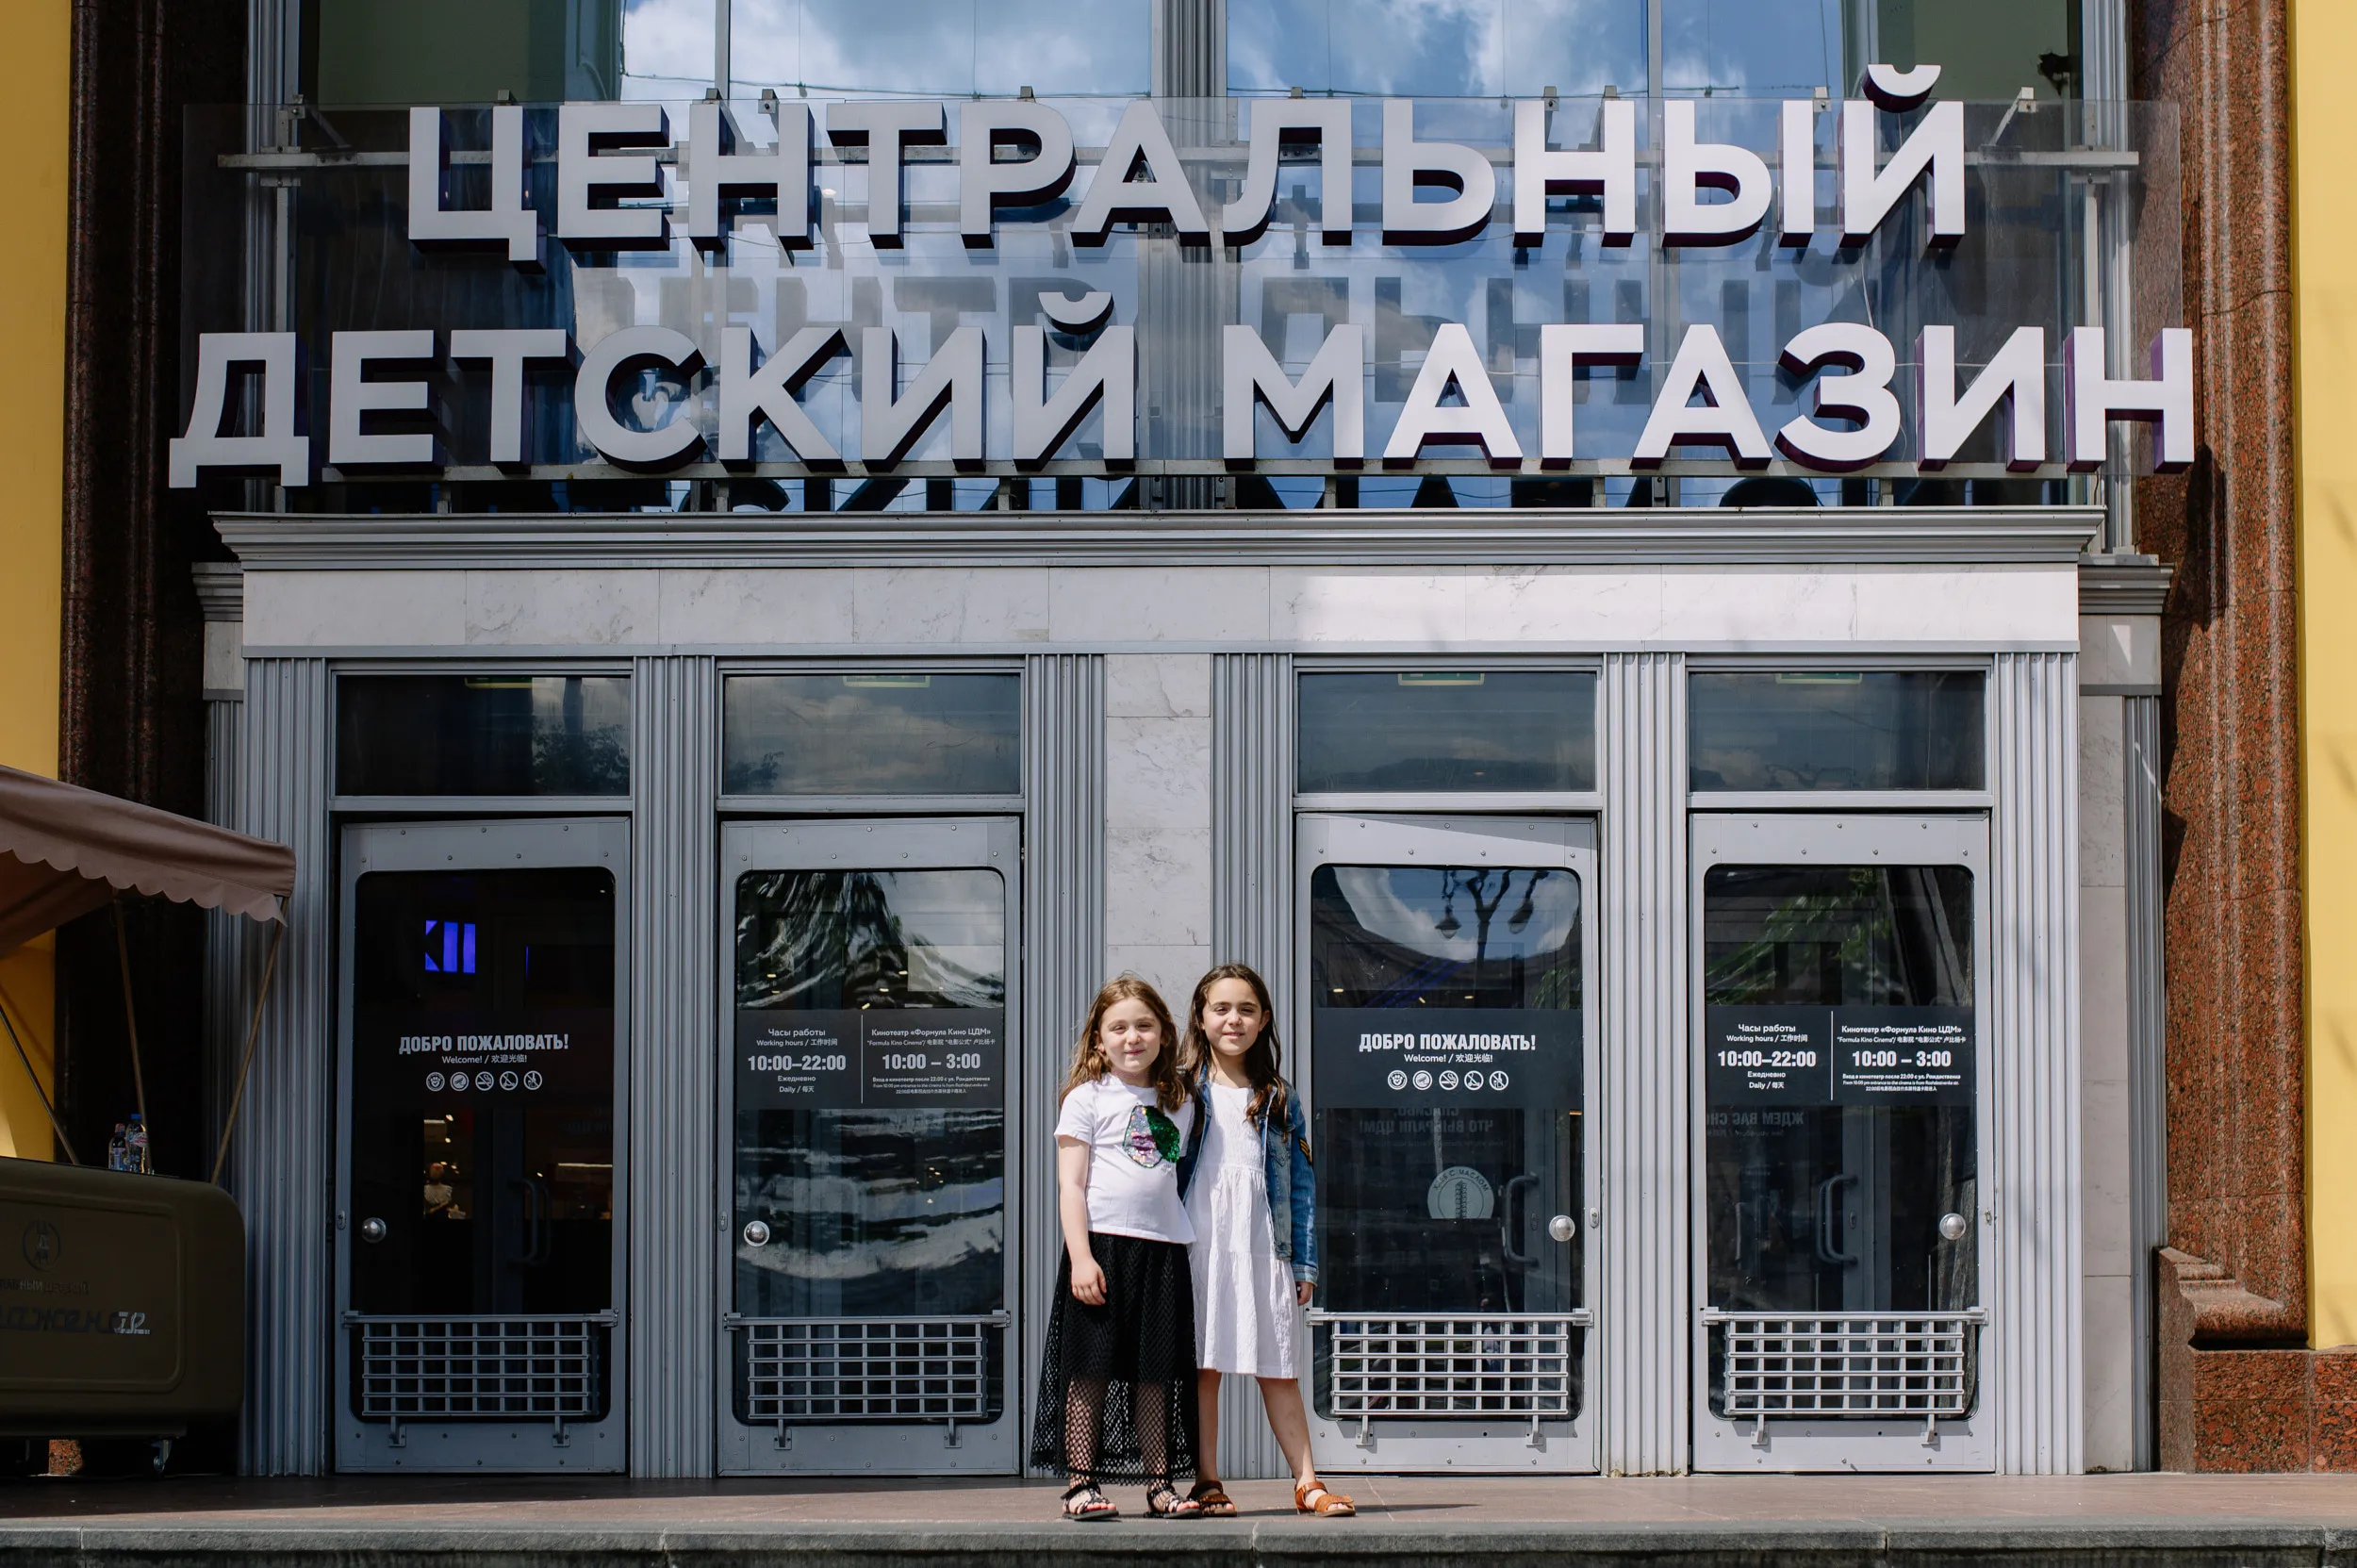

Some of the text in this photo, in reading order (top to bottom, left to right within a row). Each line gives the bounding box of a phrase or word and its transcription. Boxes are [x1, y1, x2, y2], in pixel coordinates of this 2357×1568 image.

[408, 64, 1966, 263] ЦЕНТРАЛЬНЫЙ
[170, 291, 2195, 488] ДЕТСКИЙ МАГАЗИН
[793, 1029, 826, 1037] работы
[871, 1029, 909, 1037] Кинотеатр
[1763, 1024, 1796, 1033] работы
[1841, 1025, 1879, 1034] Кинотеатр
[1880, 1025, 1917, 1034] «Формула
[1938, 1025, 1961, 1034] ЦДМ»
[399, 1033, 569, 1054] ДОБРО ПОЖАЛОВАТЬ!
[1359, 1033, 1536, 1052] ДОБРО ПОЖАЛОВАТЬ!
[441, 1055, 483, 1064] Welcome!
[882, 1054, 927, 1069] 10:00
[946, 1053, 981, 1069] 3:00
[1404, 1054, 1446, 1063] Welcome!
[1853, 1050, 1897, 1066] 10:00
[1917, 1050, 1952, 1067] 3:00
